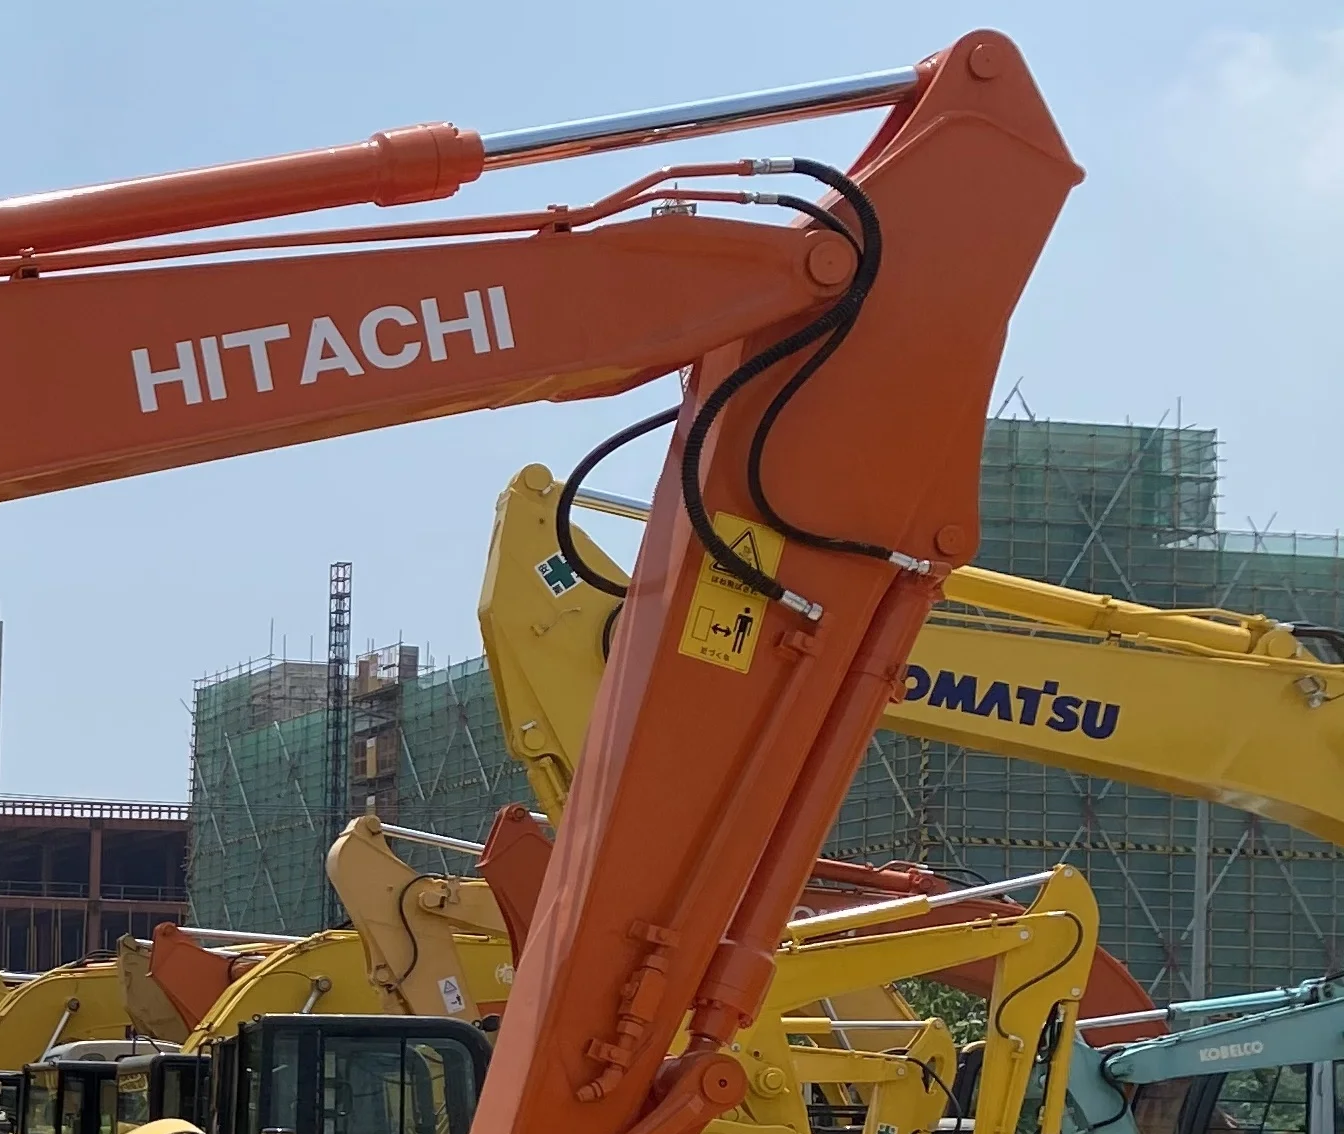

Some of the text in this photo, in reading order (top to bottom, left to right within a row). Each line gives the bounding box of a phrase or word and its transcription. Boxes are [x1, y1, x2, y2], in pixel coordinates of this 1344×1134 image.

[131, 285, 515, 414] HITACHI
[903, 664, 1120, 739] OMATSU
[1199, 1040, 1264, 1063] KOBELCO
